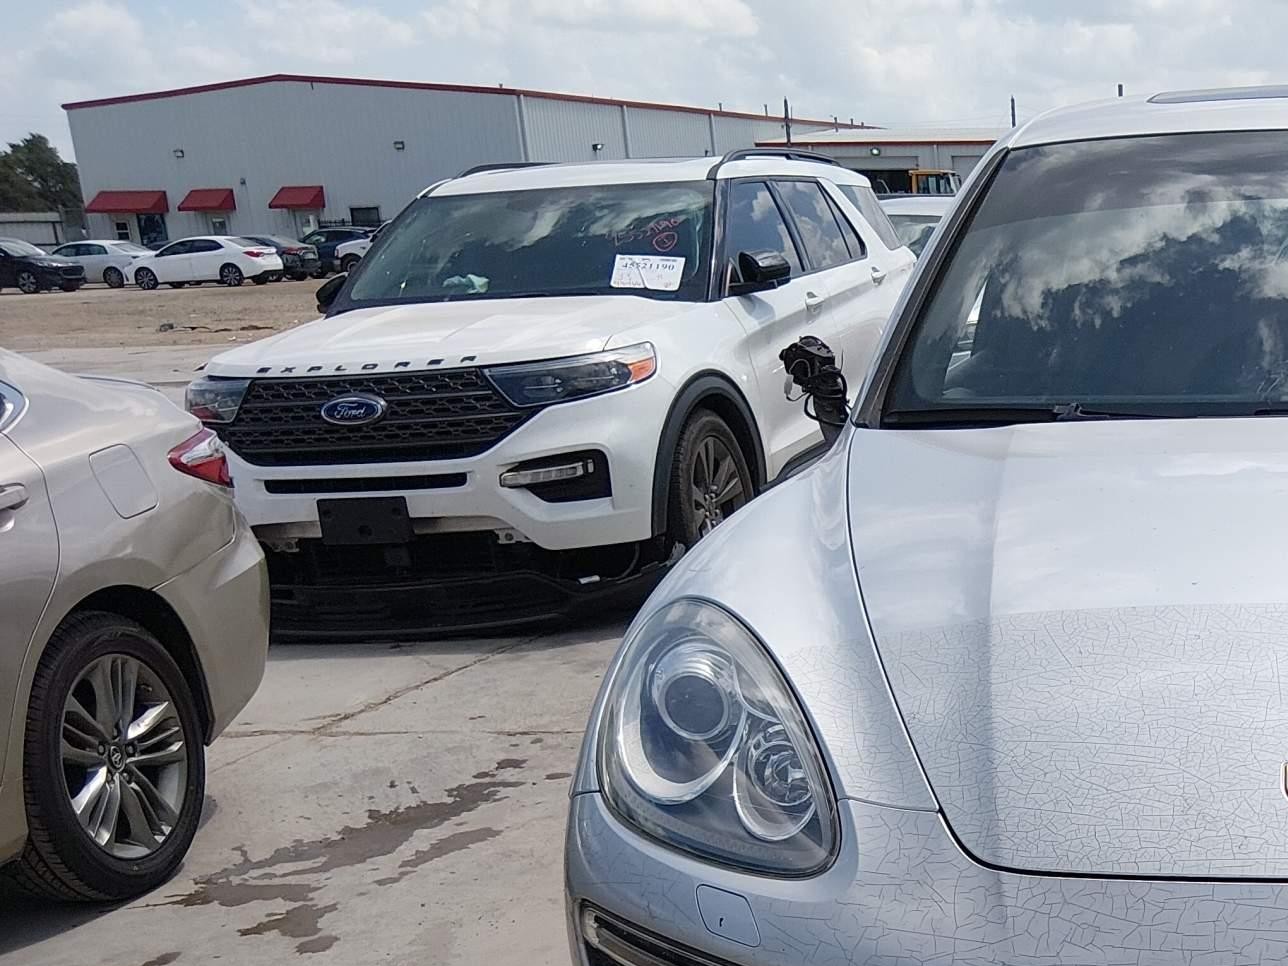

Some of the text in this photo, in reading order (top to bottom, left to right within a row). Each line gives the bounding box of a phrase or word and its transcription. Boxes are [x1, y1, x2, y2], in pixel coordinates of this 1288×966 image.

[622, 261, 676, 272] 45521190
[256, 355, 477, 374] EXPLORER
[334, 403, 367, 419] Ford
